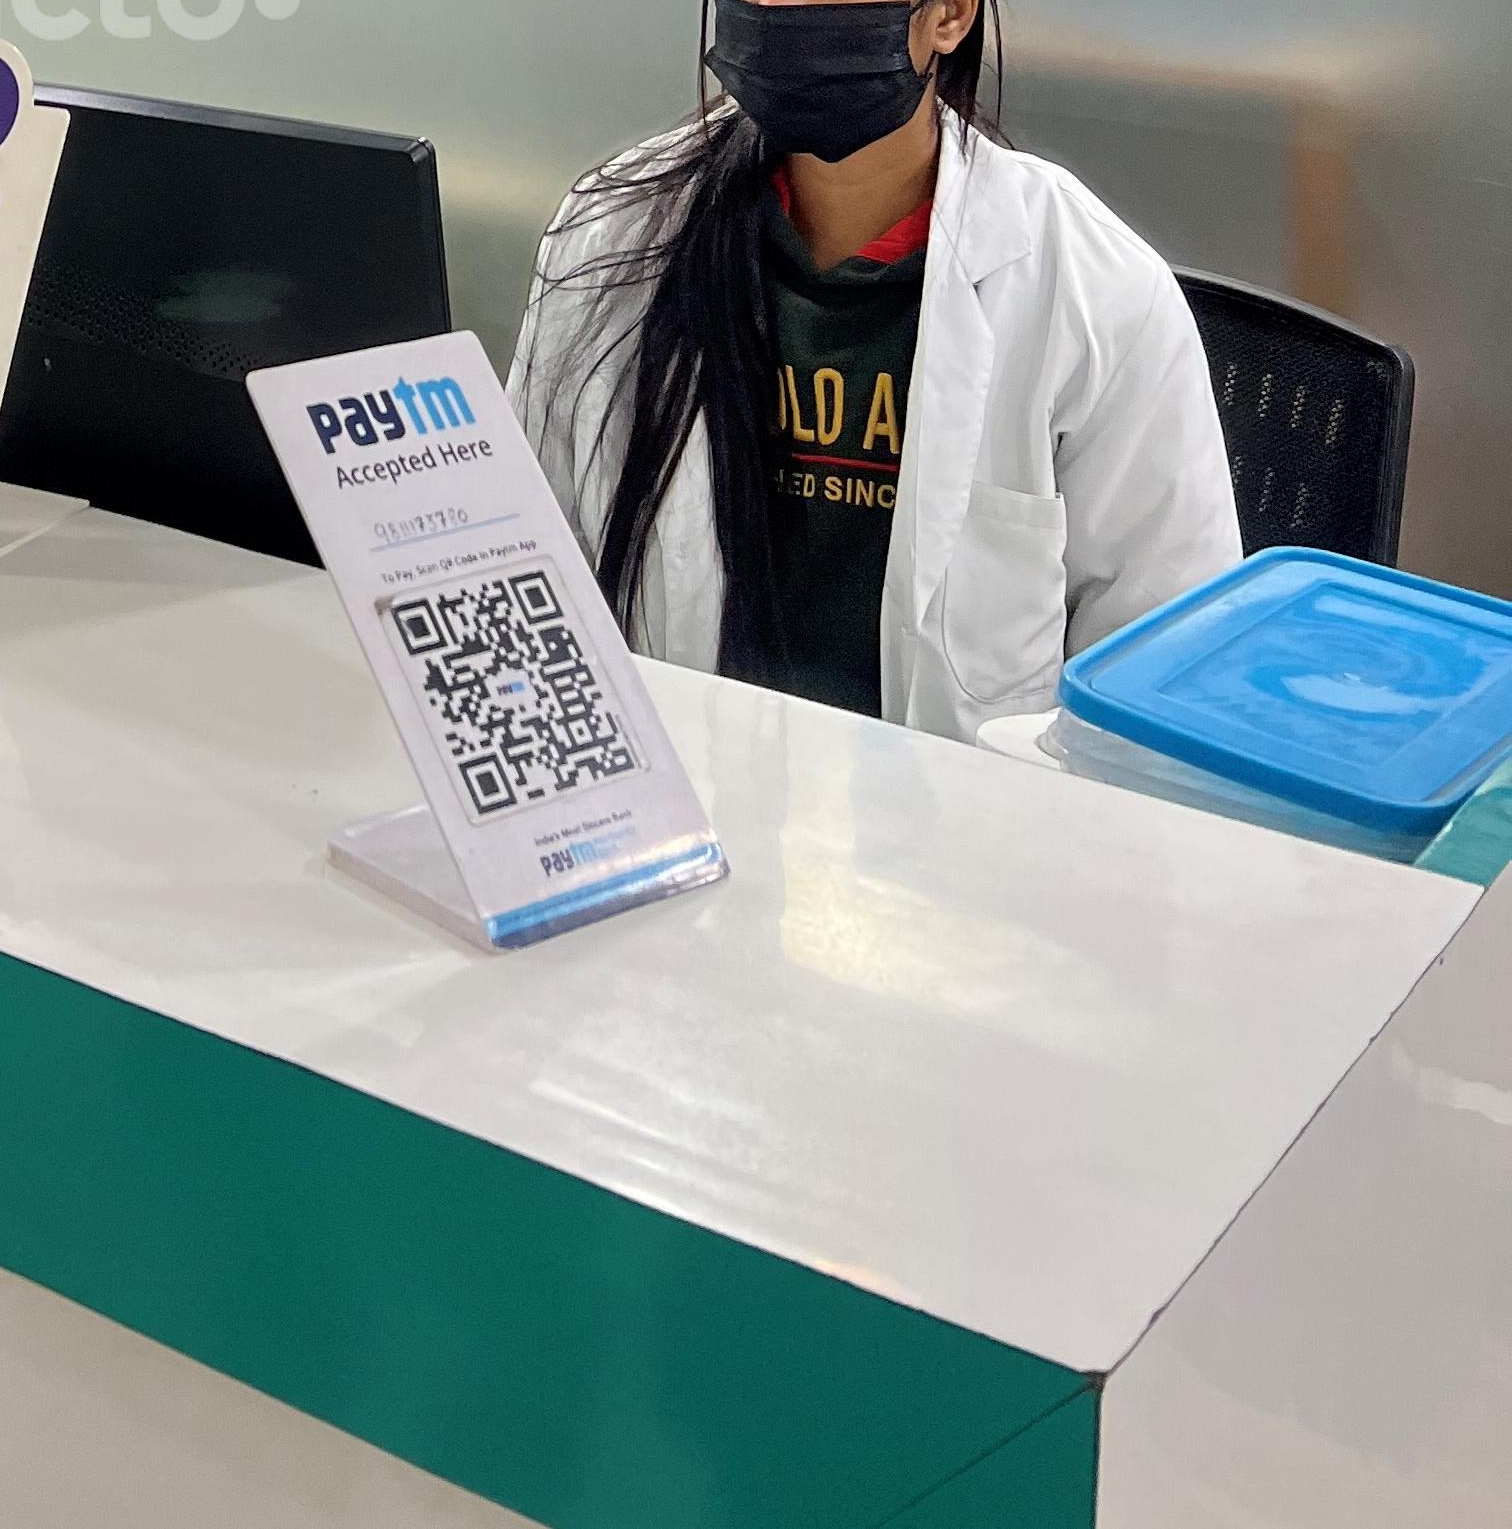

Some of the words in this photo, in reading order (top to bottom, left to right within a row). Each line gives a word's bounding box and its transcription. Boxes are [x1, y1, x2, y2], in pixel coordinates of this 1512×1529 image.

[337, 445, 437, 489] Accepted
[440, 440, 493, 465] Here
[416, 563, 438, 575] Scan
[455, 554, 478, 566] Code
[489, 543, 518, 558] Paytm
[519, 539, 537, 552] App
[612, 809, 632, 821] Bank
